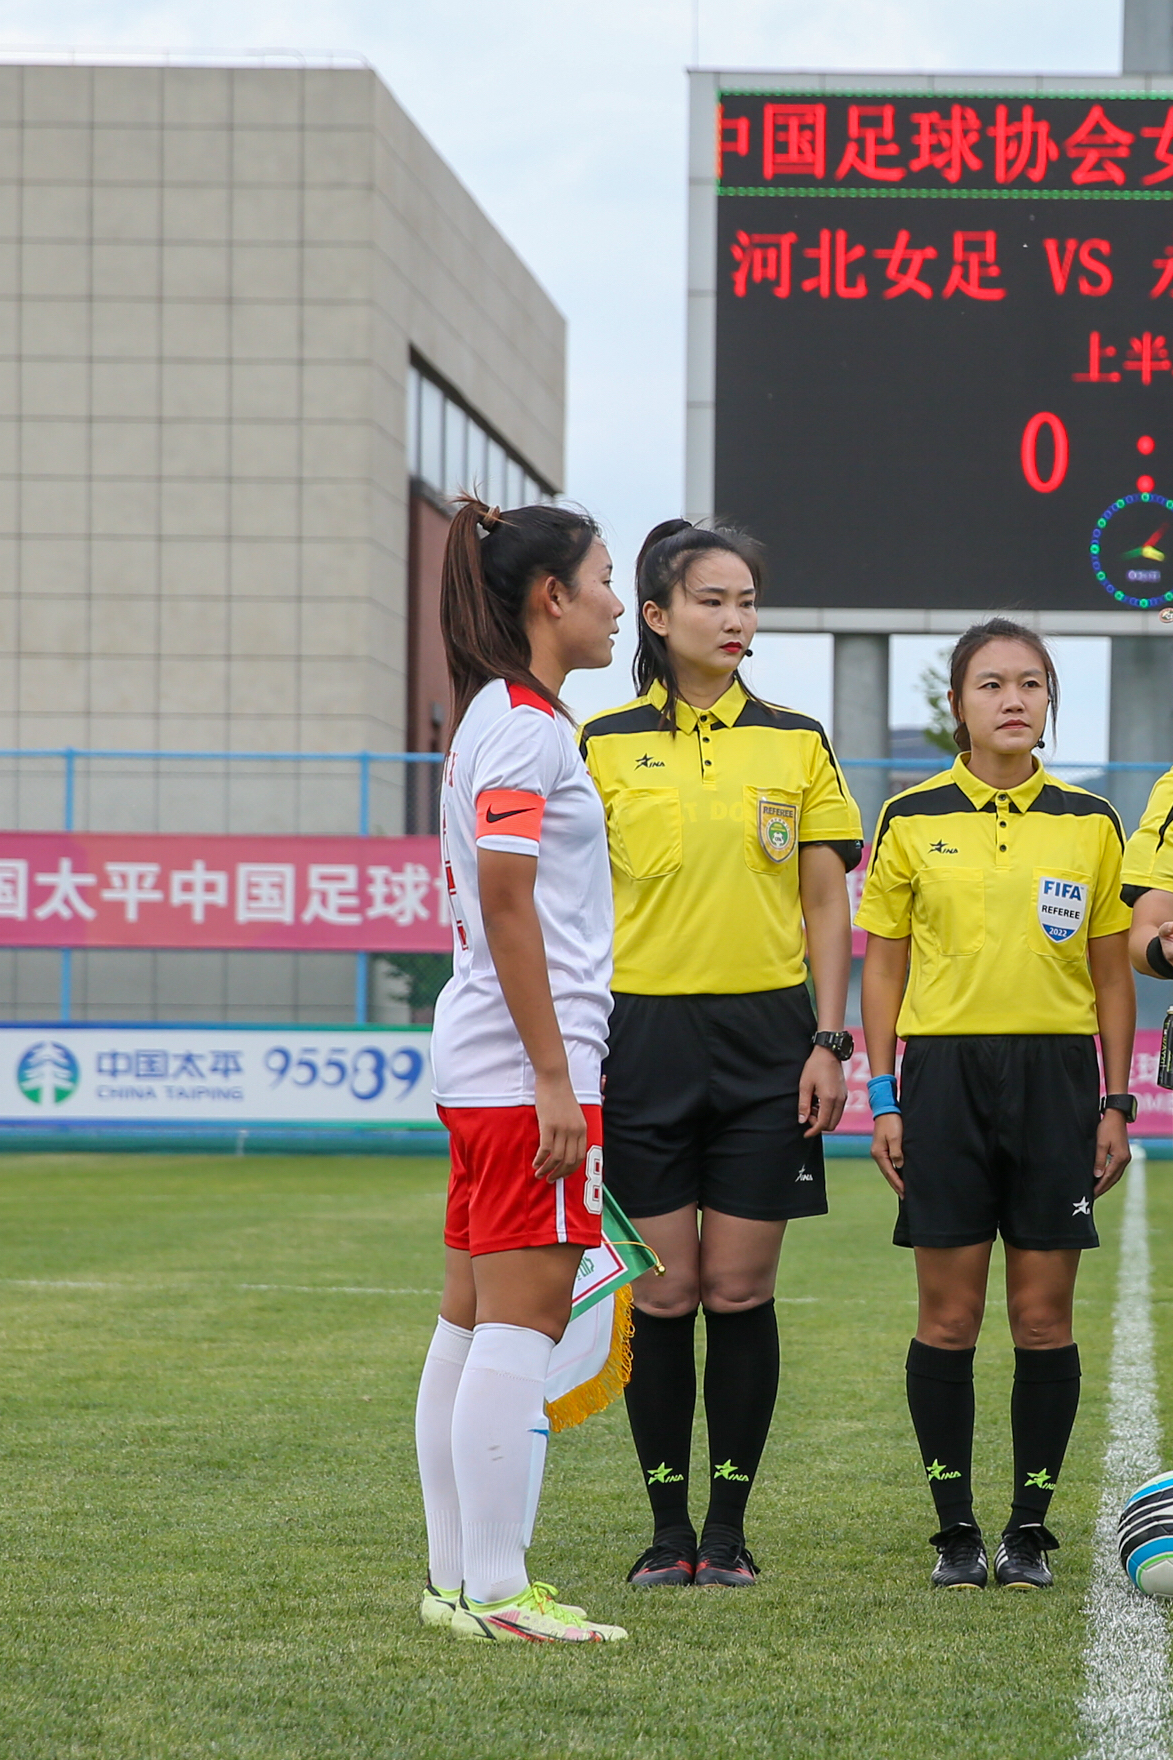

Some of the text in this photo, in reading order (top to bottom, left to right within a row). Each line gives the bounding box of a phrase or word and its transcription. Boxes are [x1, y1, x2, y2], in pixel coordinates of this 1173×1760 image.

[730, 228, 1006, 301] 河北女足
[1043, 237, 1114, 297] VS
[1020, 410, 1070, 494] 0
[763, 806, 795, 819] REFEREE
[0, 857, 450, 926] 太平中国足球
[1043, 880, 1082, 901] FIFA
[1041, 904, 1081, 920] REFEREE
[1049, 927, 1068, 938] 2022
[96, 1044, 428, 1102] 中国太平 95589
[97, 1085, 244, 1101] CHINA TAIPING
[584, 1144, 603, 1215] 8
